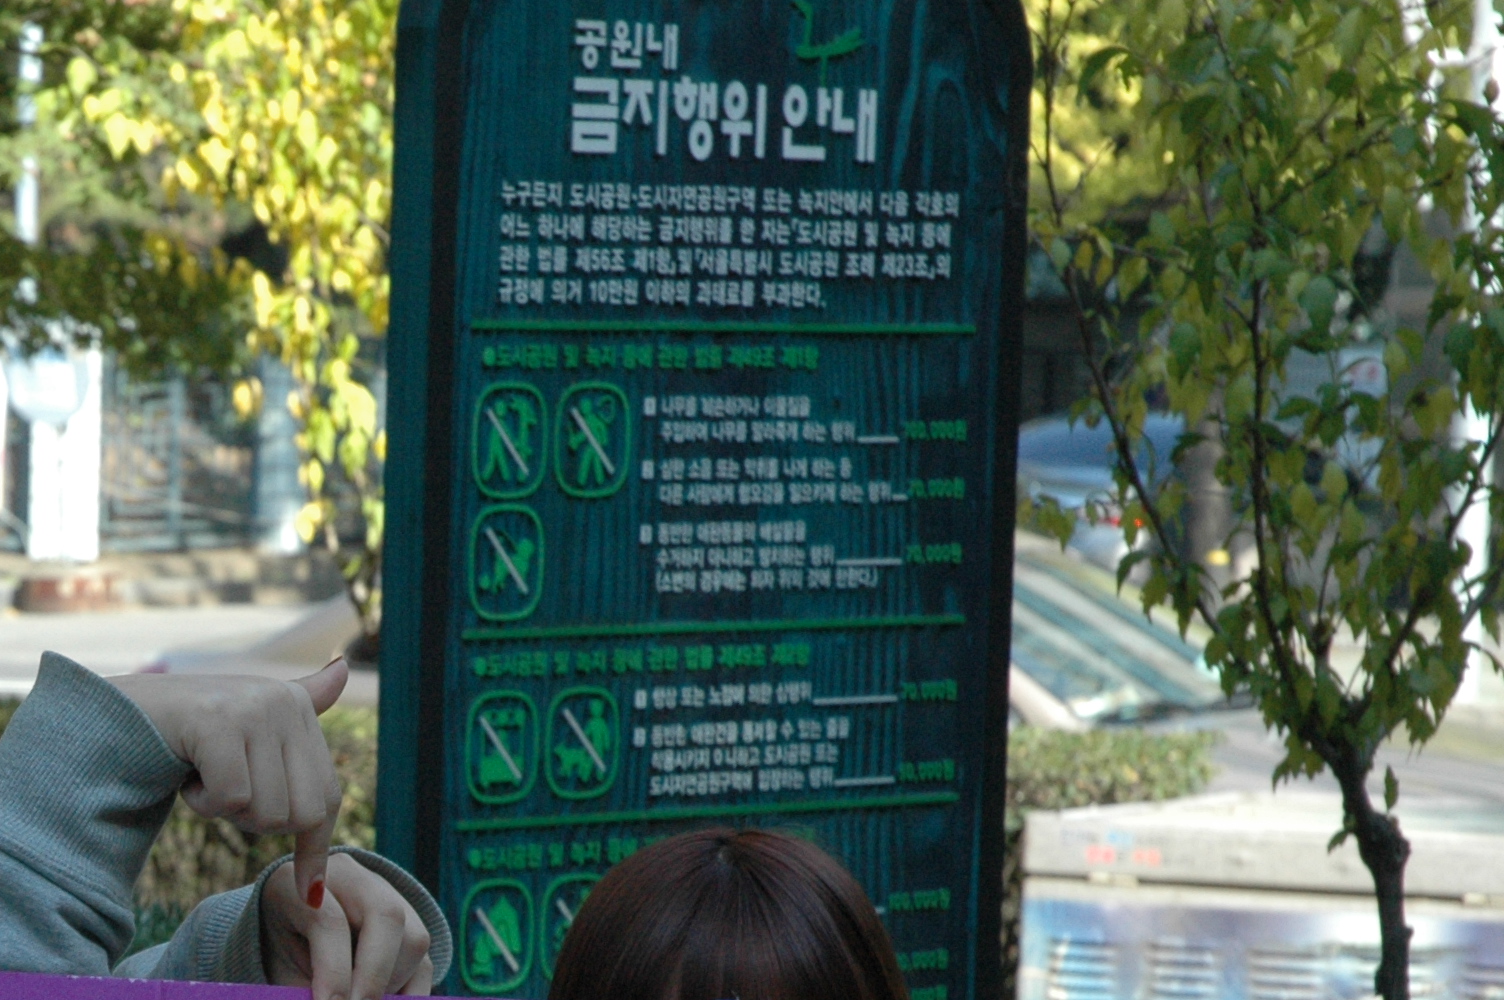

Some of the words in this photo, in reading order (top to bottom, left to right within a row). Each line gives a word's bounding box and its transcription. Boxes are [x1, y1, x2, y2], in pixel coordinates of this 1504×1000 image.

[574, 18, 680, 71] 공원내
[570, 76, 767, 162] 금지행위
[783, 84, 879, 164] 안내
